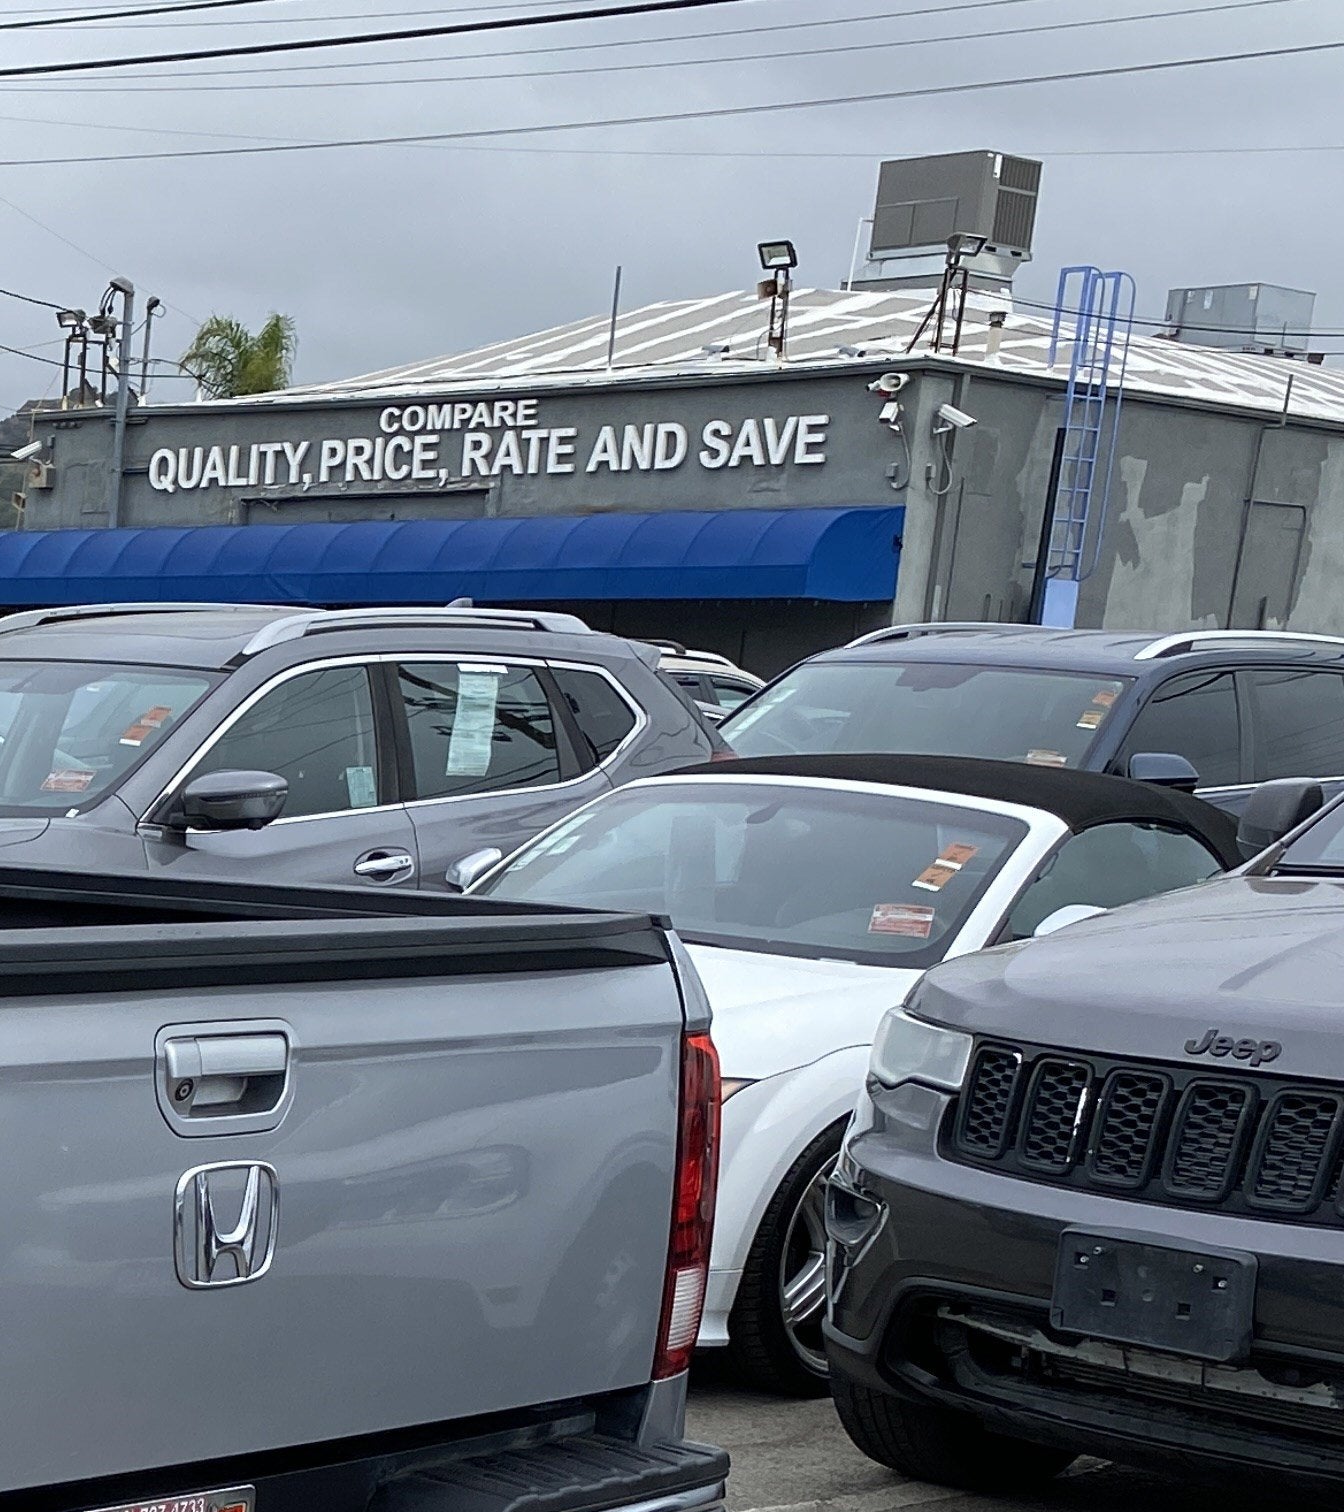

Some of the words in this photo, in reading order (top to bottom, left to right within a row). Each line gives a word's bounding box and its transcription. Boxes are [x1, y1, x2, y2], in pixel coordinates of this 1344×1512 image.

[379, 399, 539, 434] COMPARE
[148, 440, 311, 492] QUALITY,
[318, 433, 449, 485] PRICE,
[461, 427, 578, 478] RATE
[585, 421, 688, 473] AND
[699, 414, 830, 469] SAVE
[1184, 1029, 1282, 1067] Jeep
